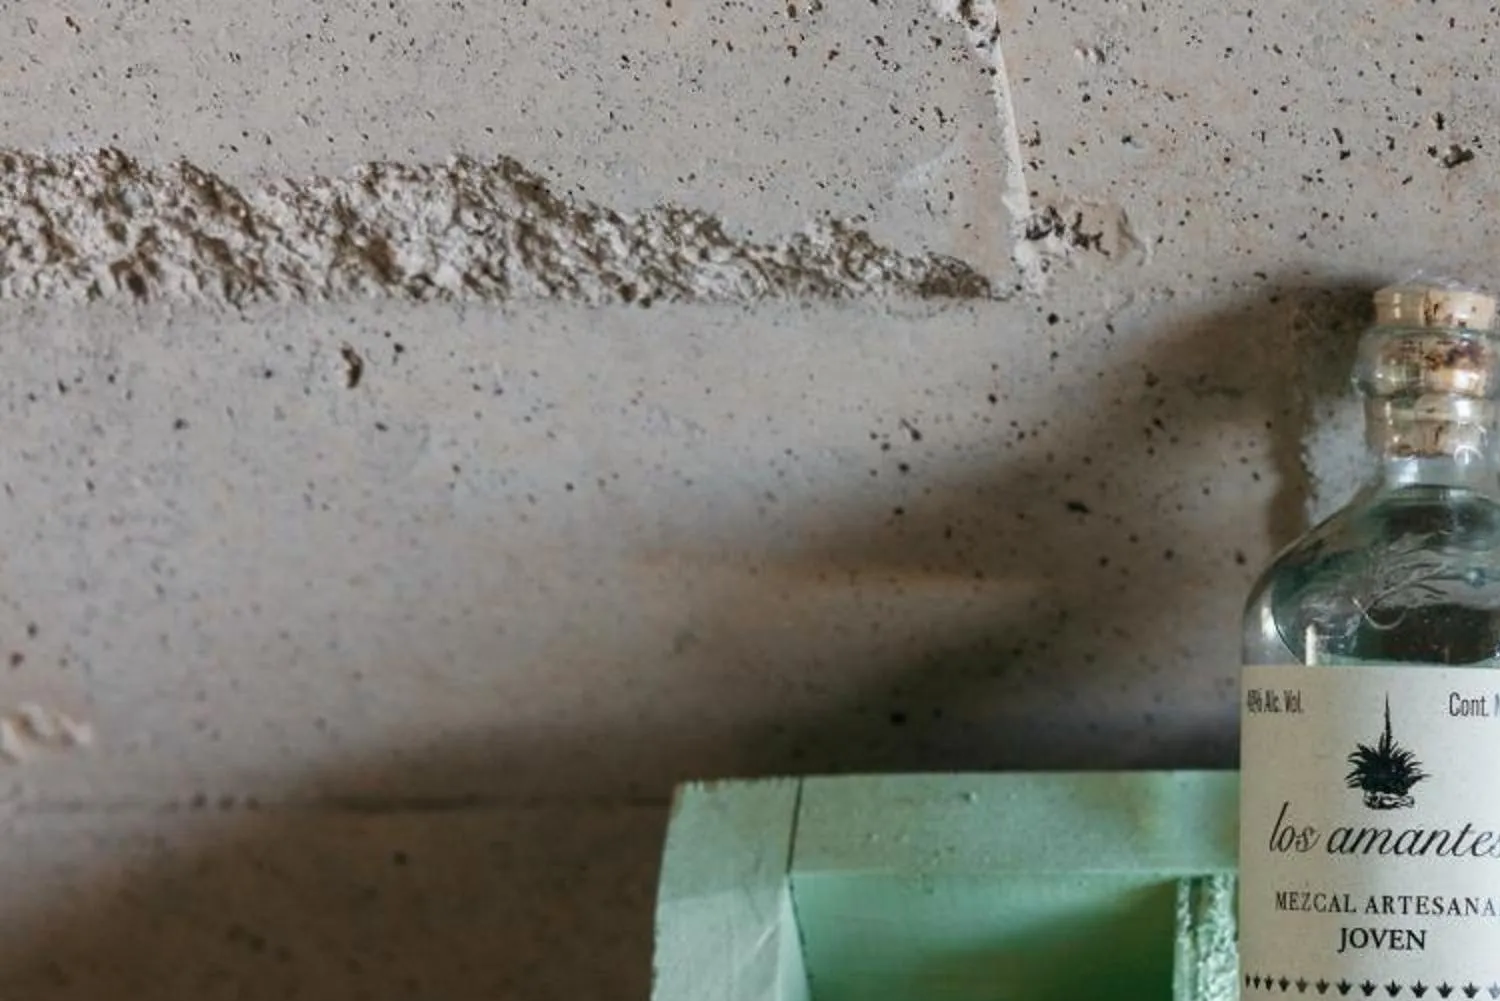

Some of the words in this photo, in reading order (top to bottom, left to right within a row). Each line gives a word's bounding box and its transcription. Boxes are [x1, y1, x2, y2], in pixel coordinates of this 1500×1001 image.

[1448, 691, 1490, 718] Cont.
[1268, 800, 1321, 853] los
[1274, 890, 1358, 915] MEZCAL
[1336, 926, 1428, 955] JOVEN
